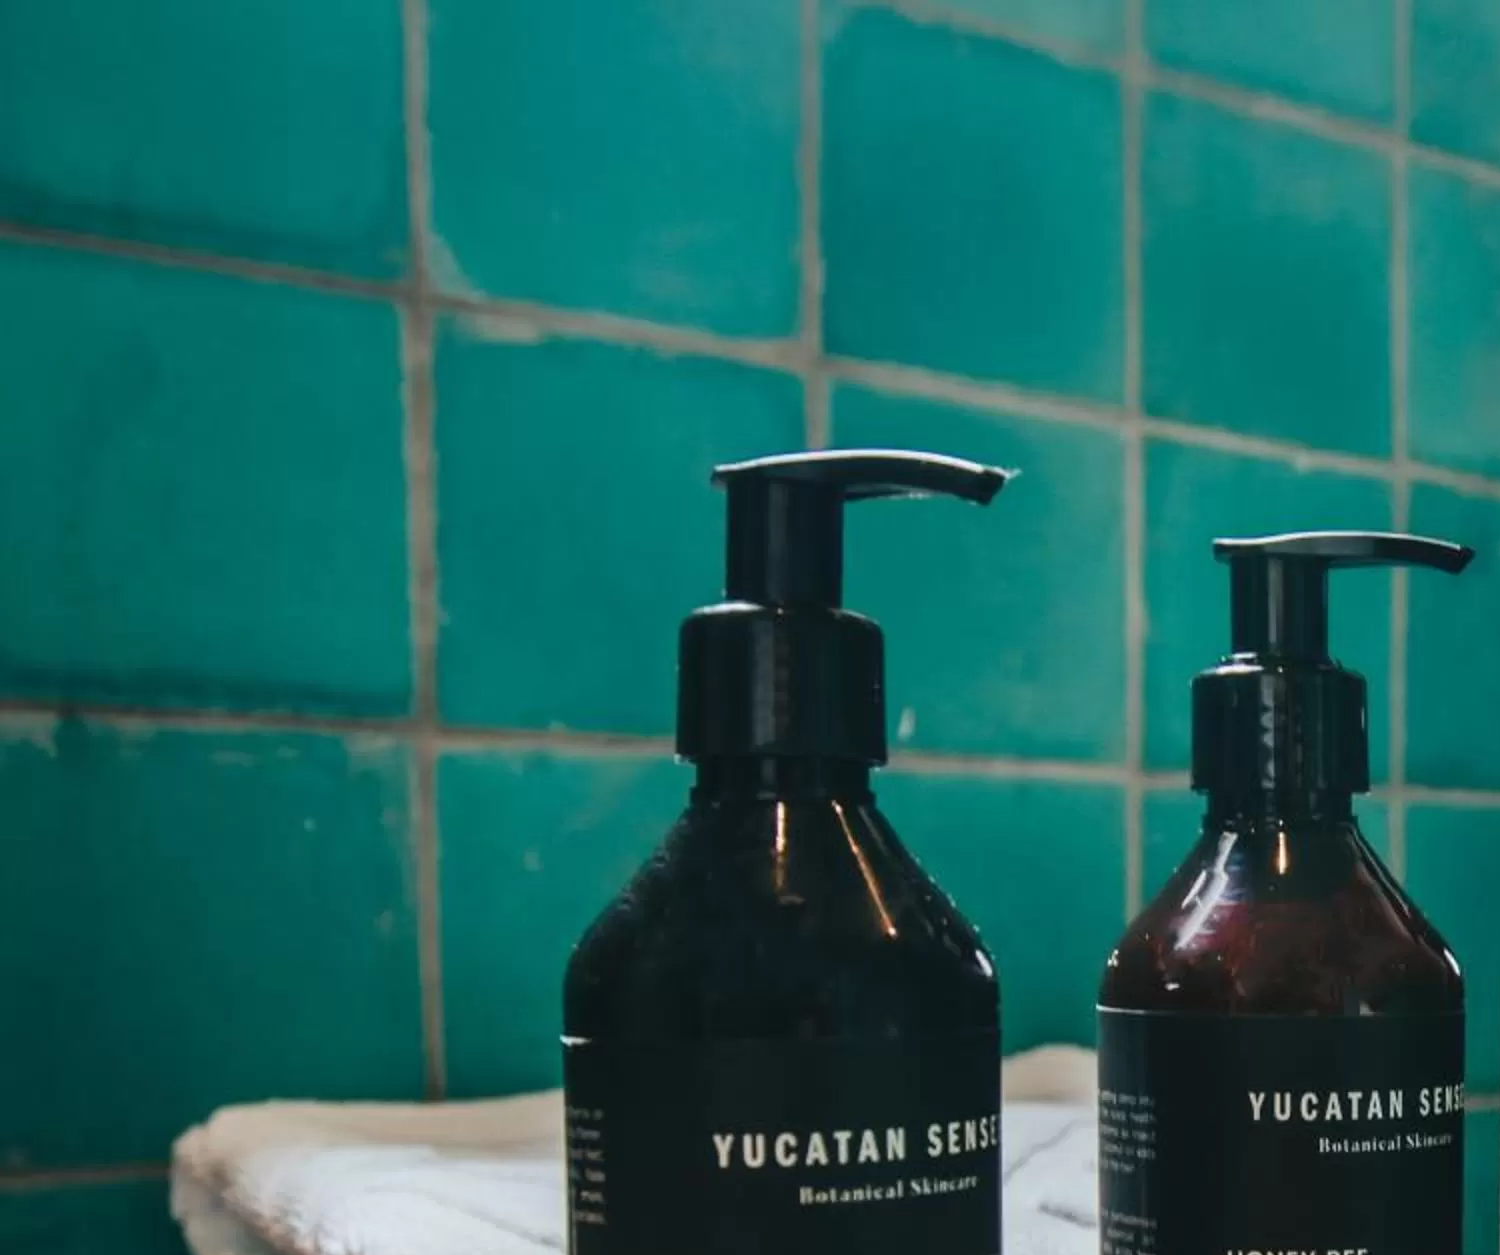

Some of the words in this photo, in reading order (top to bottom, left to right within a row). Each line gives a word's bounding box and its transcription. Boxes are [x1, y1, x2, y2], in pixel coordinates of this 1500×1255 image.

[1248, 1089, 1403, 1121] YUCATAN
[713, 1126, 906, 1168] YUCATAN
[1318, 1134, 1401, 1153] Botanical
[799, 1179, 903, 1205] Botanical
[909, 1176, 977, 1196] Skincare
